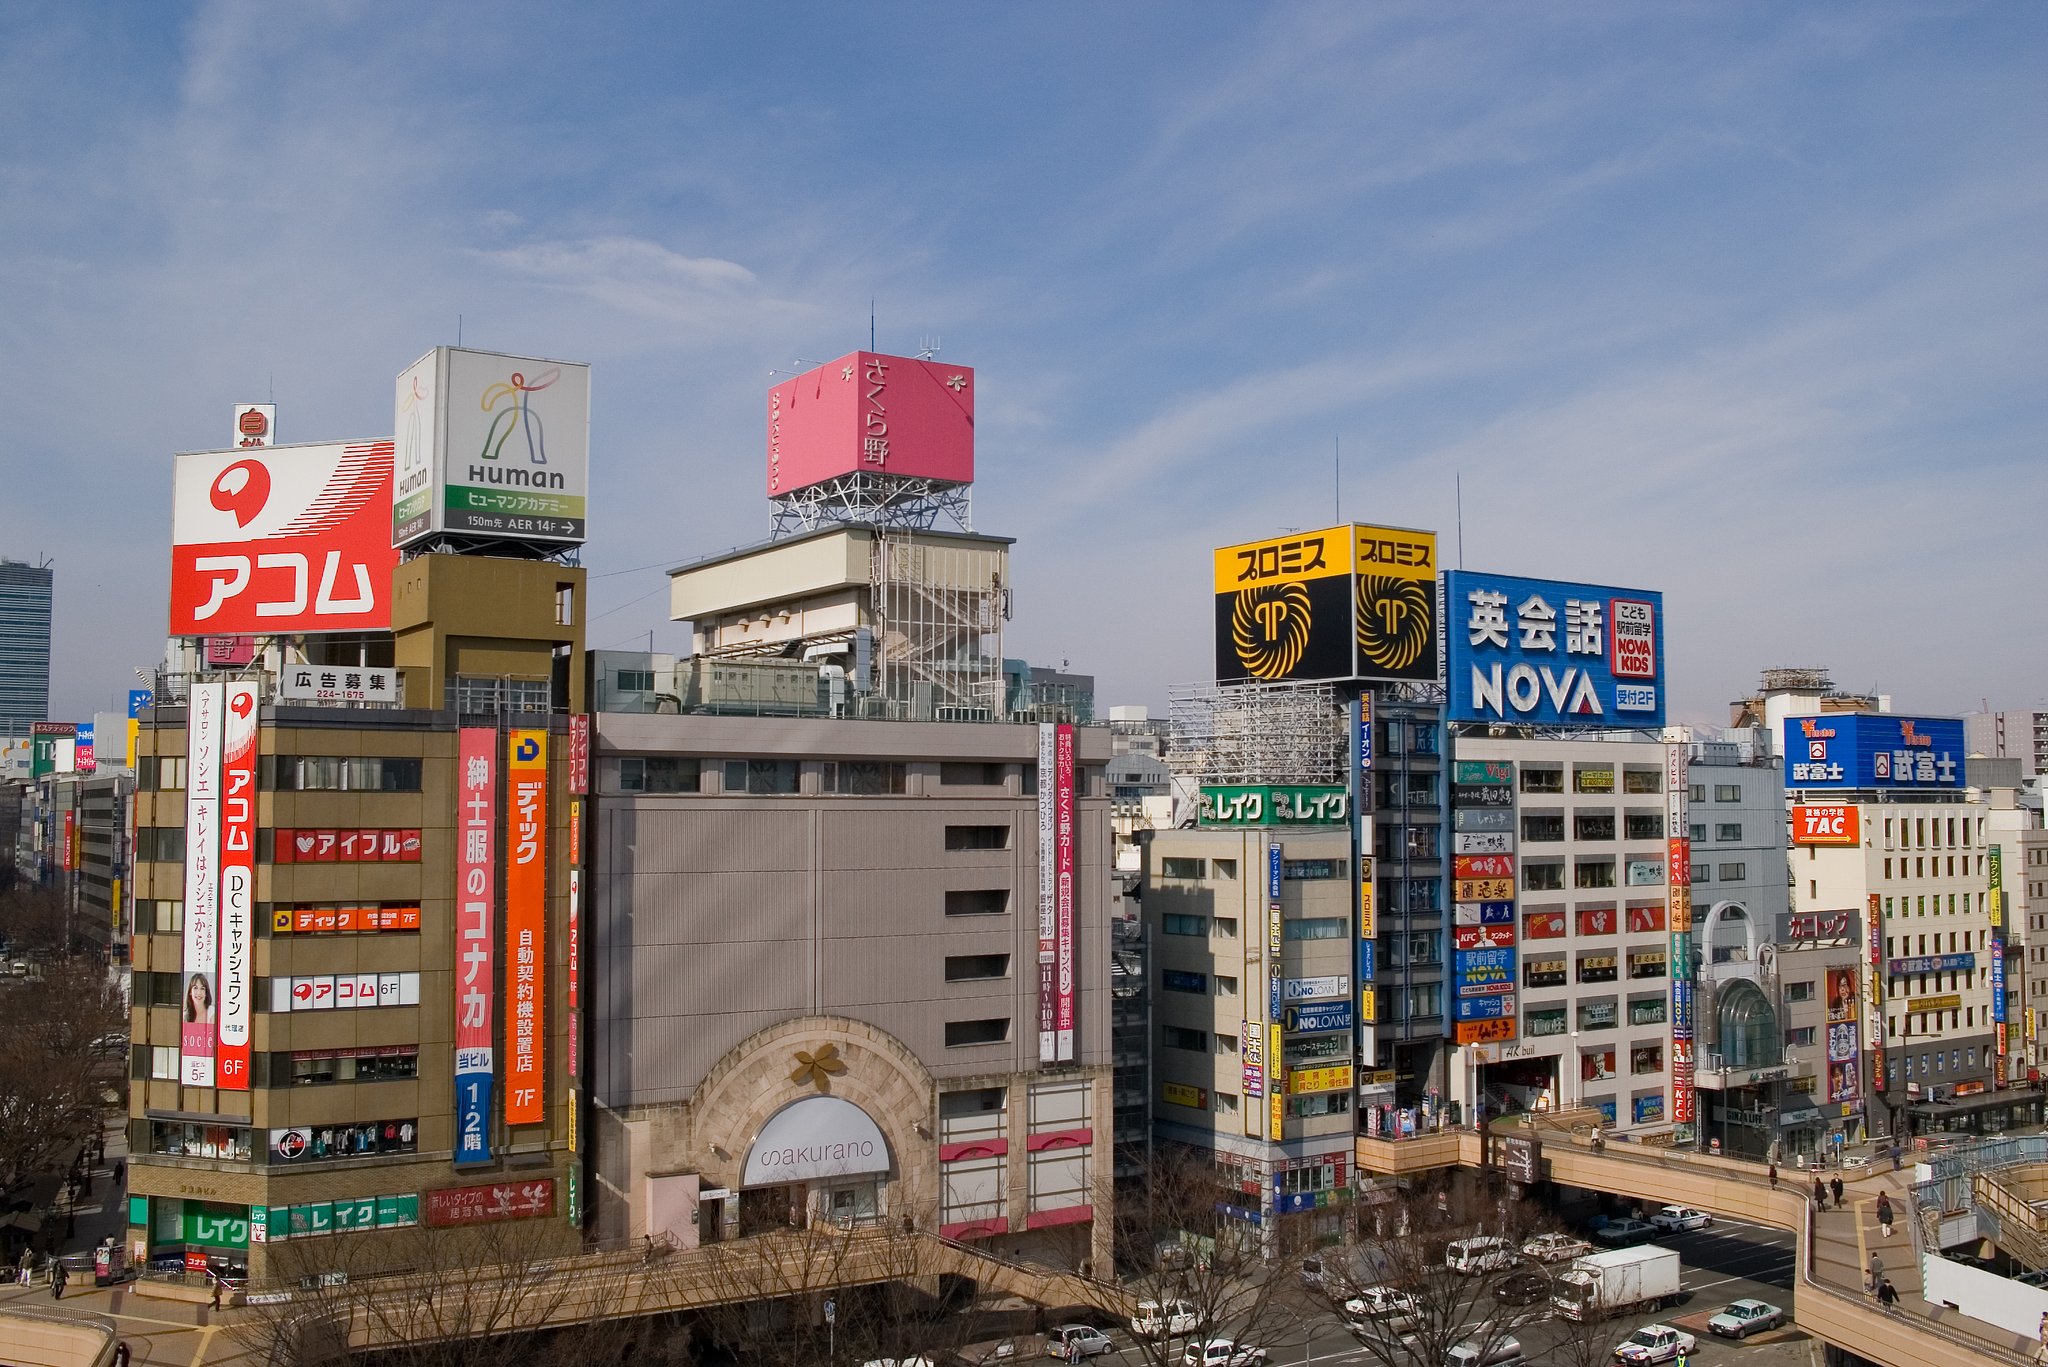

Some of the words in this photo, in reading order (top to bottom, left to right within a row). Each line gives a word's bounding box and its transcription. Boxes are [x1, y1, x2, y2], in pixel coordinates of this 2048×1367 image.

[864, 359, 888, 465] さくら野
[400, 468, 427, 496] Human
[469, 465, 565, 489] Human
[468, 492, 569, 512] ヒューマンアカデミー
[467, 516, 502, 528] 150m先
[508, 519, 532, 531] AER
[536, 520, 556, 531] 14F
[1237, 538, 1326, 582] プロミス
[1360, 538, 1431, 568] プロミス
[194, 551, 375, 620] アコム
[1468, 588, 1602, 656] 英会話
[1621, 606, 1646, 619] こども
[1616, 620, 1651, 637] 駅前留学
[1618, 638, 1651, 655] NOVA
[1621, 655, 1649, 672] KIDS
[295, 672, 386, 691] 広告募集
[1472, 661, 1603, 718] NOVA
[316, 690, 365, 700] 224-1675
[1617, 689, 1653, 706] 受付2F
[200, 689, 211, 740] ヘアサロン
[1361, 693, 1370, 722] 英会話
[1361, 724, 1370, 756] イーオン
[578, 729, 587, 787] アイフル
[1893, 750, 1956, 782] 武富士
[198, 747, 209, 792] ソシエ
[1793, 762, 1844, 780] 武富士
[228, 769, 250, 851] アコム
[1217, 793, 1262, 819] レイク
[1295, 793, 1345, 819] レイク
[1805, 808, 1844, 816] 資格の学校
[516, 782, 542, 864] ディック
[1060, 787, 1071, 870] さくら野カード
[1805, 818, 1845, 834] TAC
[317, 835, 400, 855] アイフル
[1463, 835, 1471, 850] 7F
[1471, 857, 1513, 875] つぼ八
[1672, 854, 1680, 881] つぼ八
[462, 756, 489, 1028] 紳士服のコナカ
[300, 914, 350, 927] ディック
[403, 913, 416, 923] 7F
[1789, 913, 1849, 938] カニトップ
[1041, 942, 1054, 950] 7階
[1461, 933, 1476, 941] KFC
[1466, 950, 1507, 966] 駅前留学
[1466, 965, 1507, 983] NOVA
[315, 983, 375, 999] アコム
[381, 984, 398, 995] 6F
[516, 929, 534, 1073] 自動契約機設置店
[1479, 999, 1500, 1007] キャッシュ
[1060, 998, 1070, 1029] 開催中
[1485, 1008, 1500, 1016] プラザ
[459, 1053, 489, 1069] 当ビル
[1506, 1046, 1520, 1058] AK
[191, 1069, 205, 1081] 5F
[224, 1060, 244, 1075] 6F
[515, 1089, 535, 1106] 7F
[1675, 1089, 1683, 1118] KFC
[251, 1213, 266, 1221] レイク
[313, 1206, 373, 1228] レイク
[197, 1216, 248, 1243] レイク
[188, 1258, 207, 1267] コナカ
